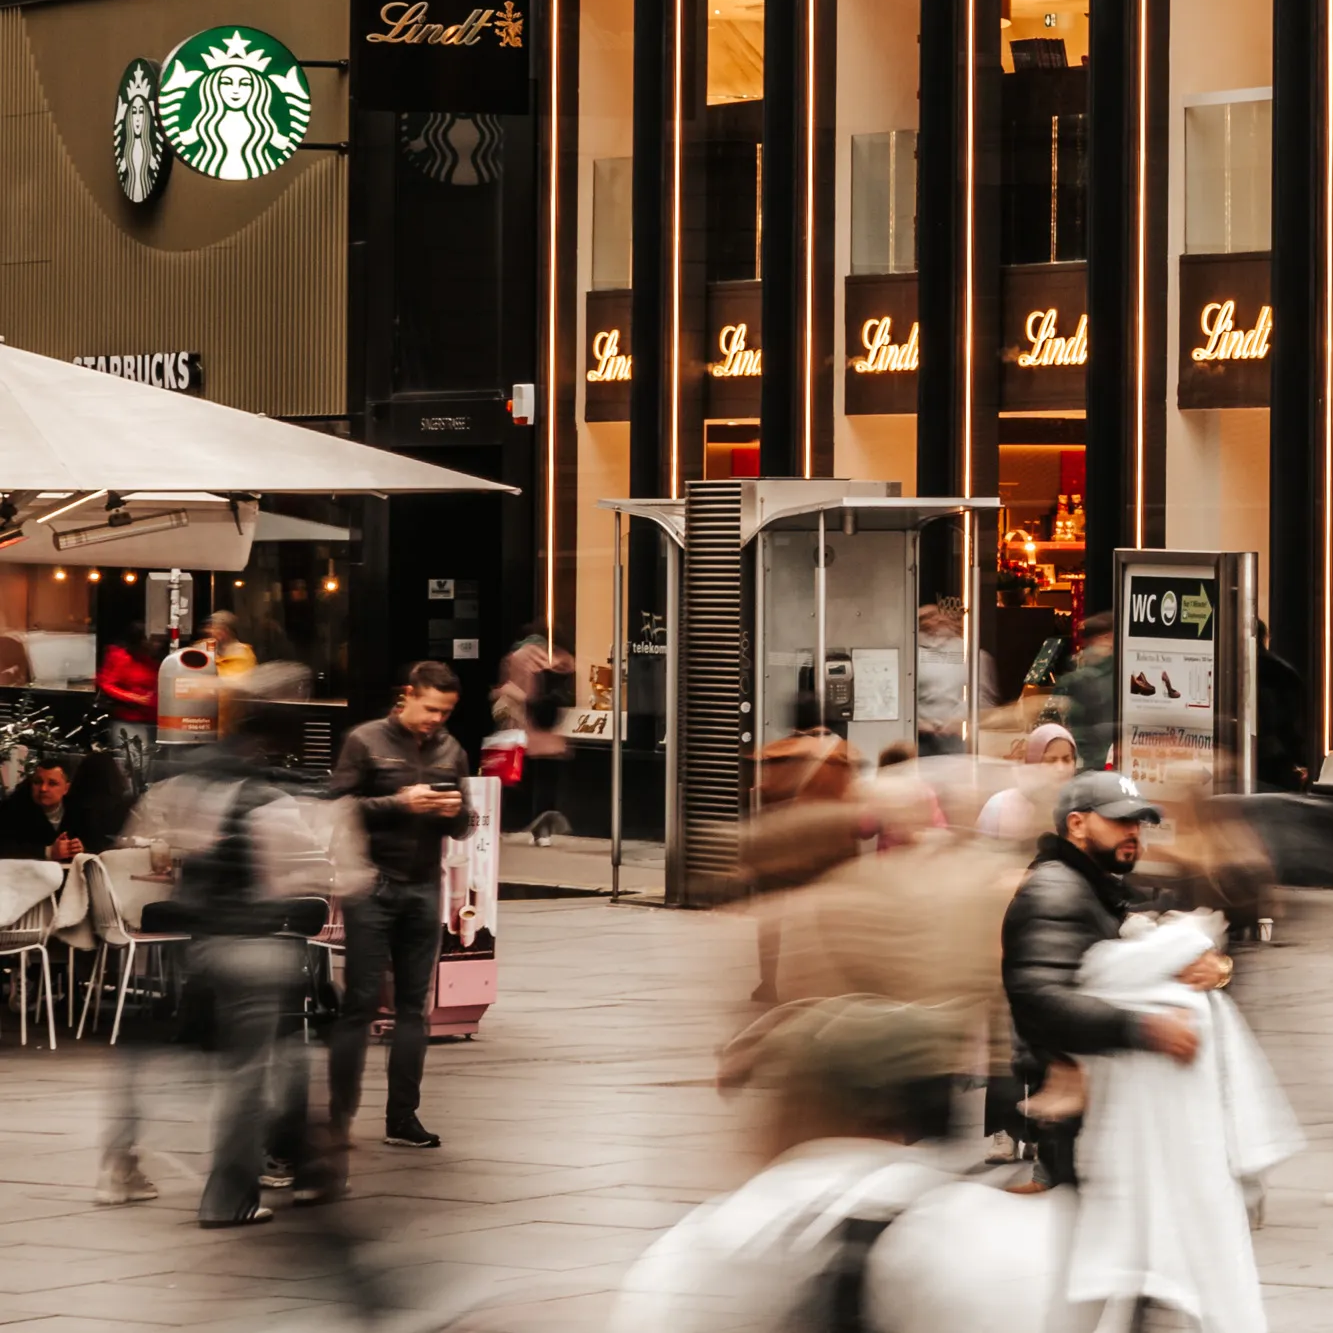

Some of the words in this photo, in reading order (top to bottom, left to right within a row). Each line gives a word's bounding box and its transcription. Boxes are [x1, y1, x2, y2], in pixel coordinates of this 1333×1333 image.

[366, 0, 495, 47] Lindt
[854, 315, 919, 374] Lind
[73, 351, 190, 390] RBUCKS
[1132, 593, 1157, 624] WC
